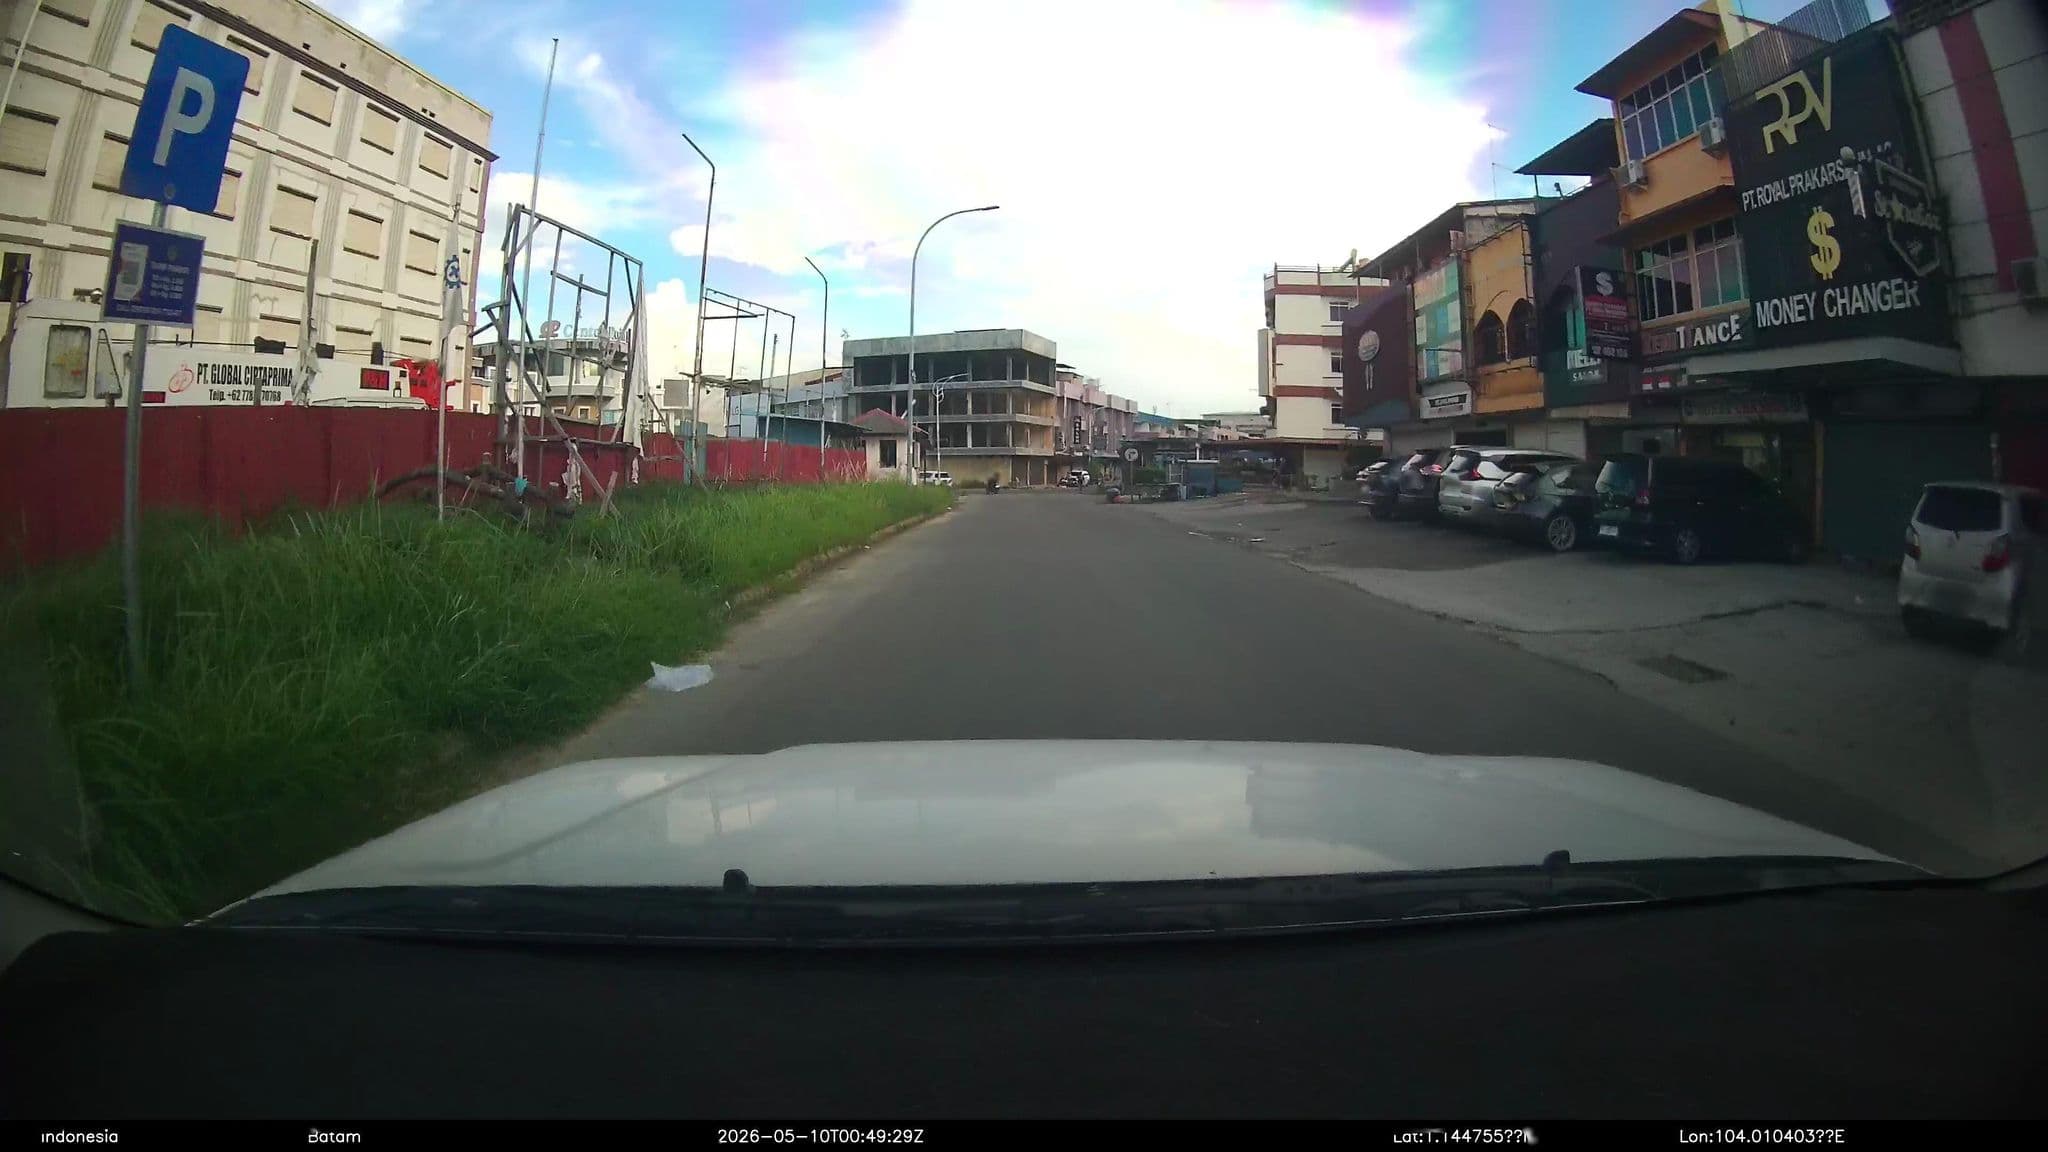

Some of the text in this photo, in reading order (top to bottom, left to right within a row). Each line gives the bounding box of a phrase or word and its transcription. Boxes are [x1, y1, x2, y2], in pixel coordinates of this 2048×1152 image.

[153, 66, 216, 166] P
[1757, 181, 1790, 206] ROYAL
[1788, 158, 1855, 197] PRAKARS
[1596, 271, 1614, 296] S
[1755, 278, 1921, 328] MONEY CHANGER
[197, 363, 208, 384] PT.
[211, 363, 242, 385] GLOBAL
[227, 389, 241, 401] +62
